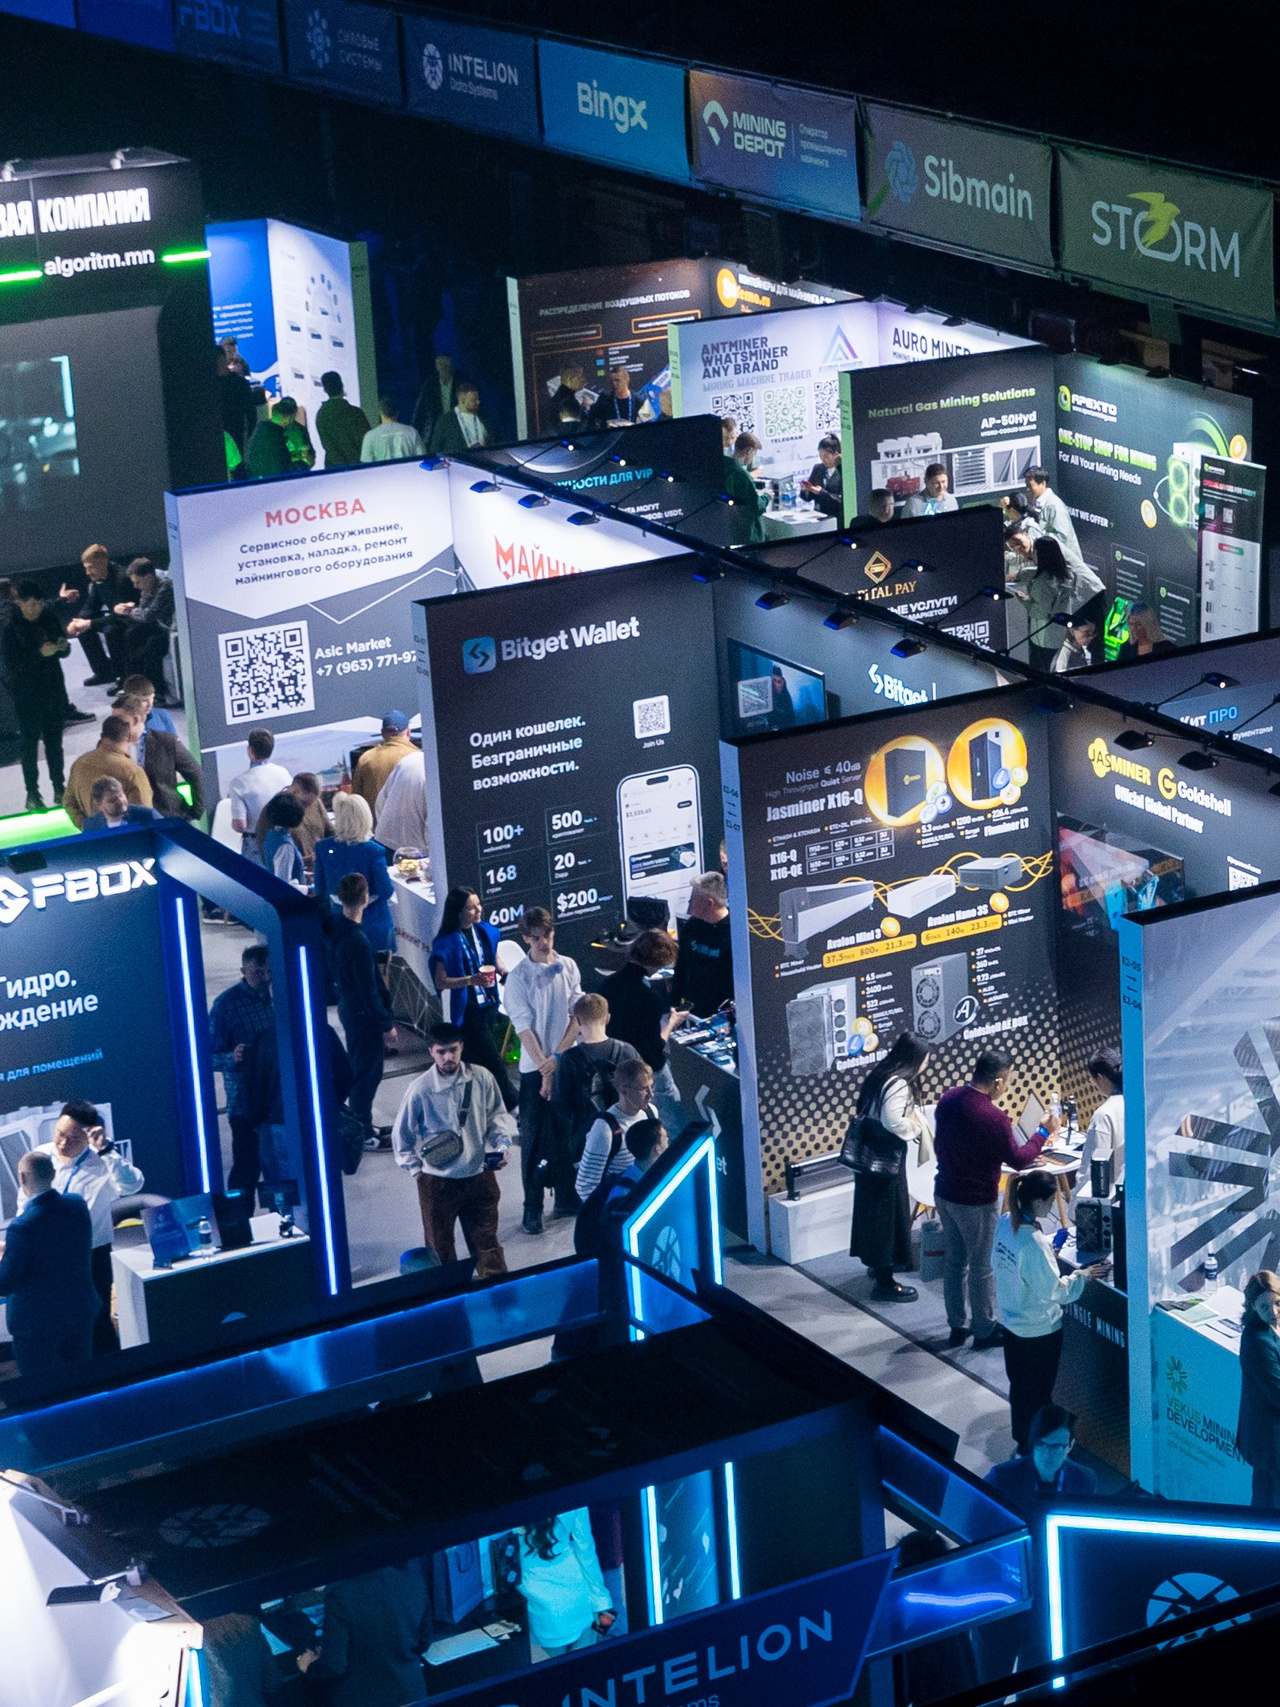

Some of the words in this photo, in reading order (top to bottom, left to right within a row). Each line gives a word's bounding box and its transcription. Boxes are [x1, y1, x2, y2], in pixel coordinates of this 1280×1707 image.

[449, 53, 519, 86] INTELION
[577, 81, 649, 134] Bingx
[733, 110, 787, 140] MINING
[733, 131, 786, 159] DEPOT
[923, 155, 1034, 221] Sibmain
[38, 187, 151, 233] КОМПАНИЯ
[1090, 198, 1241, 278] STORM
[44, 249, 156, 278] algoritm.mn
[655, 289, 691, 303] ПОТОКОВ
[701, 336, 769, 356] ANTMINER
[893, 327, 929, 355] AURO
[701, 346, 789, 367] WHATSMINER
[702, 363, 731, 380] ANY
[733, 358, 779, 376] BRAND
[868, 403, 913, 420] Natural
[915, 400, 938, 414] Gas
[940, 393, 980, 410] Mining
[981, 386, 1036, 403] Solutions
[980, 411, 1037, 431] AP-50Hyd
[609, 471, 634, 486] ДЛЯ
[635, 468, 654, 481] VIP
[1058, 451, 1070, 463] For
[1070, 454, 1079, 466] All
[1079, 457, 1096, 471] Your
[1096, 462, 1119, 481] Mining
[1119, 469, 1142, 486] Needs
[264, 498, 367, 530] МОСКВА
[239, 536, 308, 556] Сервисное
[310, 521, 404, 549] обслуживание,
[236, 550, 306, 573] установка,
[308, 543, 361, 564] наладка,
[364, 534, 410, 556] ремонт
[234, 564, 323, 587] майнингового
[325, 548, 414, 576] оборудования
[895, 580, 918, 595] PAY
[909, 595, 958, 613] УСЛУГИ
[315, 642, 352, 661] Asic
[353, 635, 392, 655] Market
[501, 629, 569, 662] Bitget
[569, 616, 641, 648] Wallet
[316, 664, 333, 679] +7
[335, 656, 375, 678] (963)
[1208, 705, 1239, 724] ПРО
[469, 728, 512, 749] Один
[515, 715, 587, 739] кошелек.
[471, 736, 584, 770] Безграничные
[472, 760, 580, 791] возможности.
[786, 768, 820, 784] Noise
[820, 777, 840, 788] Quiet
[766, 799, 826, 822] Jasminer
[827, 788, 864, 810] X16-Q
[1177, 780, 1232, 817] Goldshell
[551, 810, 582, 831] 500
[1144, 794, 1171, 820] Global
[1172, 805, 1204, 834] Partner
[483, 824, 525, 844] 100+
[553, 852, 576, 871] 20
[770, 848, 798, 866] X16-Q
[31, 857, 158, 910] FBOX
[486, 864, 517, 885] 168
[770, 863, 803, 881] X16-QE
[556, 888, 598, 912] $200
[489, 904, 525, 926] 60M
[927, 911, 955, 928] Avalon
[826, 934, 856, 951] Avalon
[1121, 955, 1142, 973] E2-05
[963, 1023, 1001, 1041] Goldshell
[7, 1064, 30, 1083] для
[32, 1048, 104, 1075] помещений
